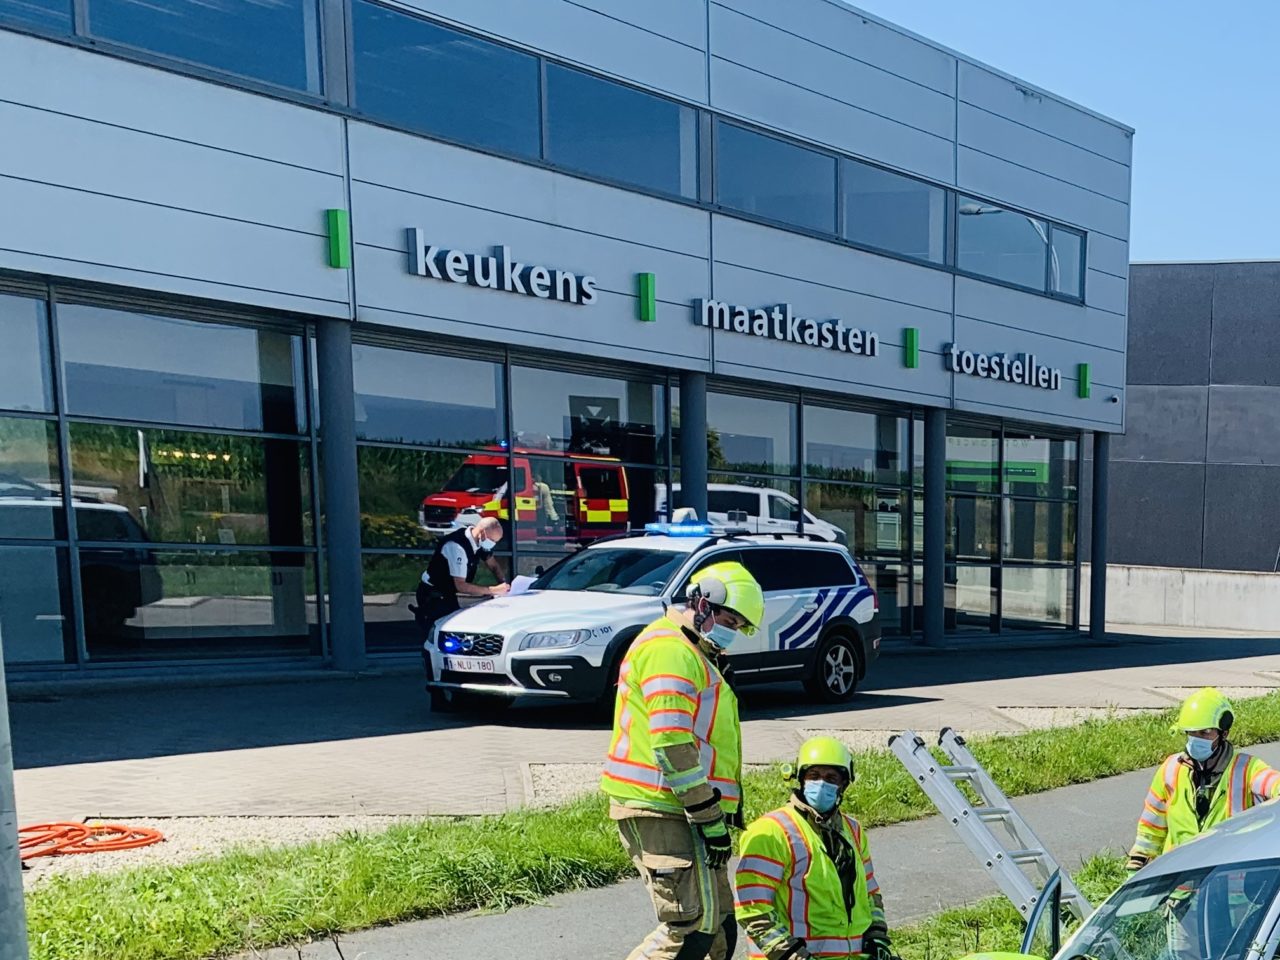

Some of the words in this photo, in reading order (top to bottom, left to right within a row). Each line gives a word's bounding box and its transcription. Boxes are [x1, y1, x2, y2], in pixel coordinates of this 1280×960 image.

[408, 227, 599, 305] keukens
[697, 298, 880, 357] maatkasten
[946, 341, 1062, 391] toestellen
[599, 625, 613, 635] 101
